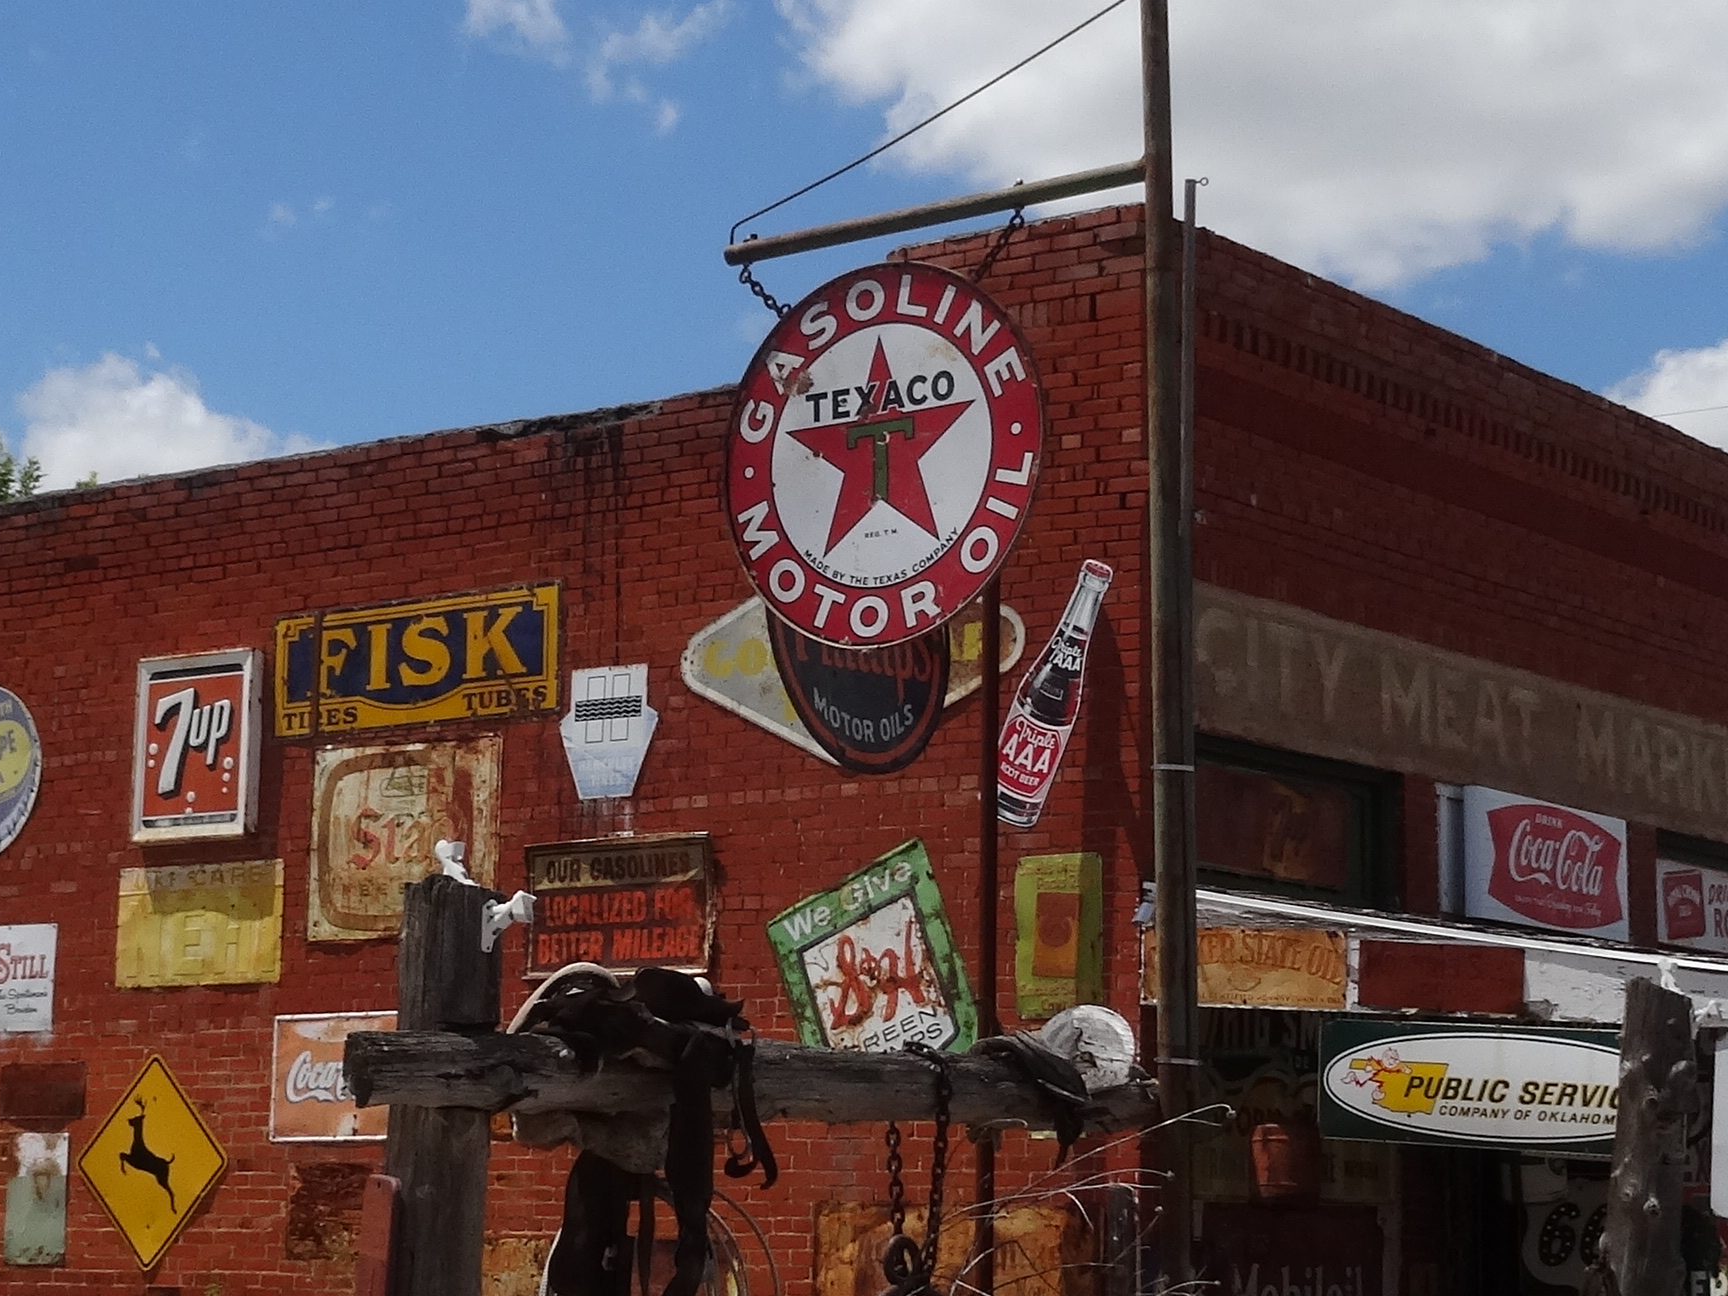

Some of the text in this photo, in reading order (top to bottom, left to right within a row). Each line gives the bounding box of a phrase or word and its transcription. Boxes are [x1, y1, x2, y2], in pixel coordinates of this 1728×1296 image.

[739, 273, 1027, 444] GASOLINE
[805, 370, 956, 424] TEXACO
[737, 451, 1034, 639] MOTOR OIL
[802, 526, 960, 586] MADE BY THE TEXAS COMPANY
[317, 604, 527, 694] FISK
[282, 684, 549, 733] TIRES TUBES
[1194, 606, 1346, 722] CITY
[1380, 660, 1541, 765] MEAT
[813, 686, 915, 744] MOTOR OILS
[1015, 717, 1057, 750] Triple
[1002, 733, 1051, 774] AAA
[1534, 813, 1564, 829] DRINK
[545, 850, 691, 884] OUR GASOLINES
[1508, 818, 1604, 897] Coca-Cola
[544, 886, 695, 927] LOCALIZED FOR
[783, 859, 914, 942] We Give
[537, 925, 700, 965] BETTER MILEAGE
[1244, 933, 1302, 971] STATE
[862, 1006, 939, 1052] REEN
[1404, 1075, 1620, 1109] PUBLIC SERVIC
[1438, 1104, 1617, 1125] COMPANY OF OKLAHOM
